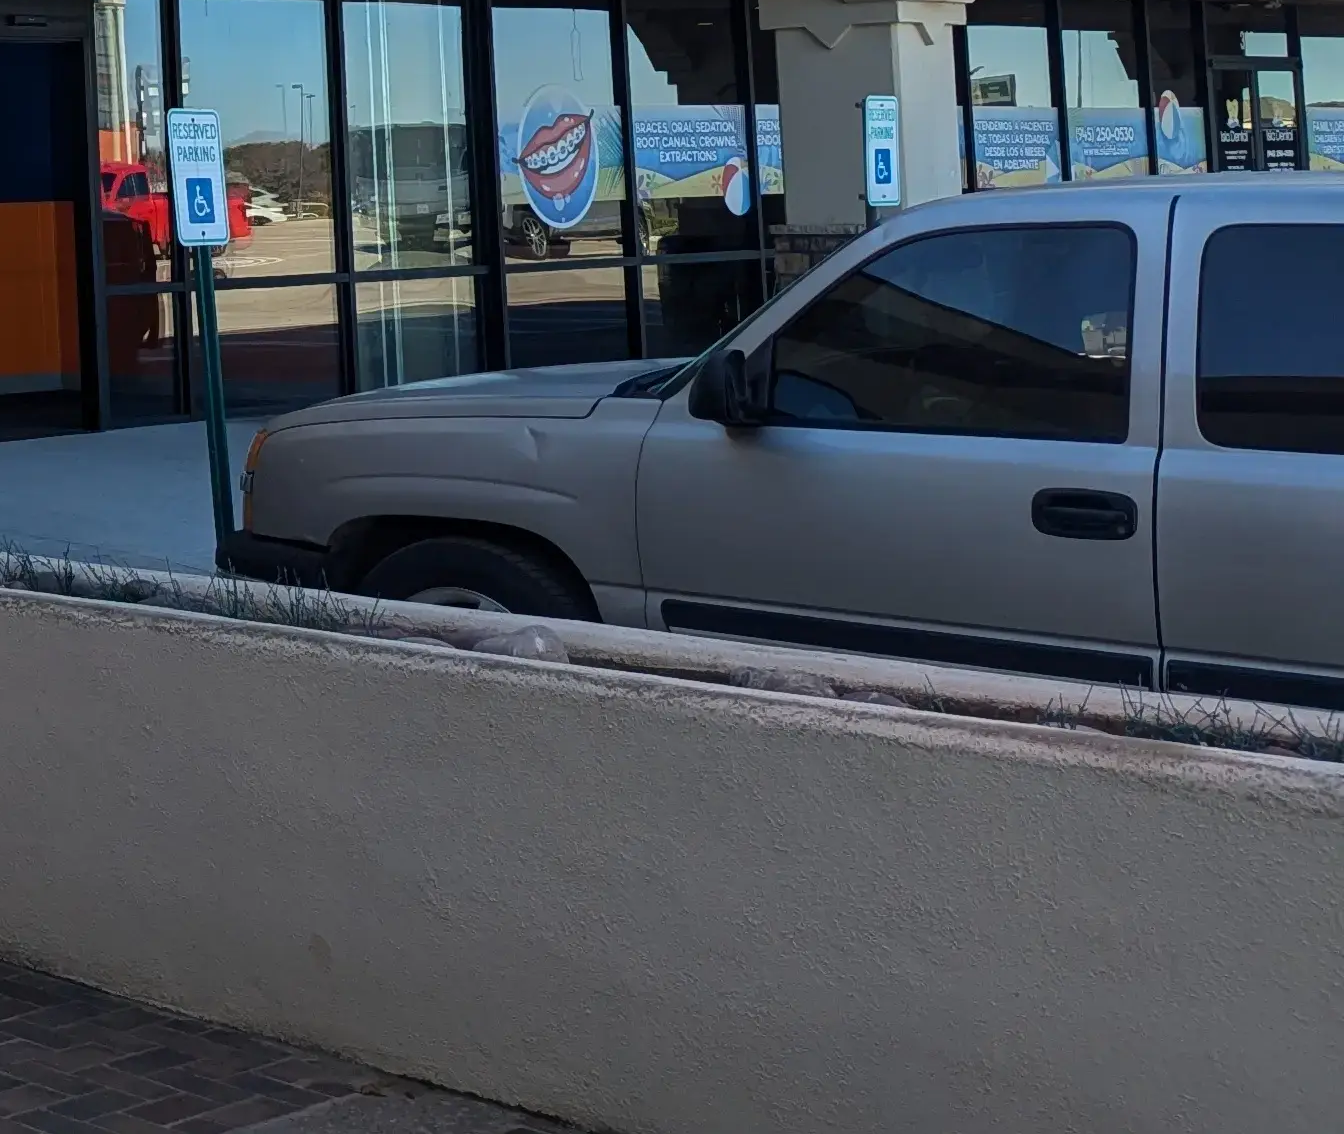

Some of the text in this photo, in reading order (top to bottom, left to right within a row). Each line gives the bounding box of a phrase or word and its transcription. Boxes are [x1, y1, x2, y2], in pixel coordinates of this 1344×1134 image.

[172, 123, 216, 140] RESERVED
[635, 121, 737, 134] BRACES, ORAL SEDATION,
[1096, 126, 1134, 141] 250-0530
[636, 136, 737, 148] ROOT CANALS, CROWNS,
[177, 146, 215, 162] PARKING
[660, 151, 717, 163] EXTRACTIONS
